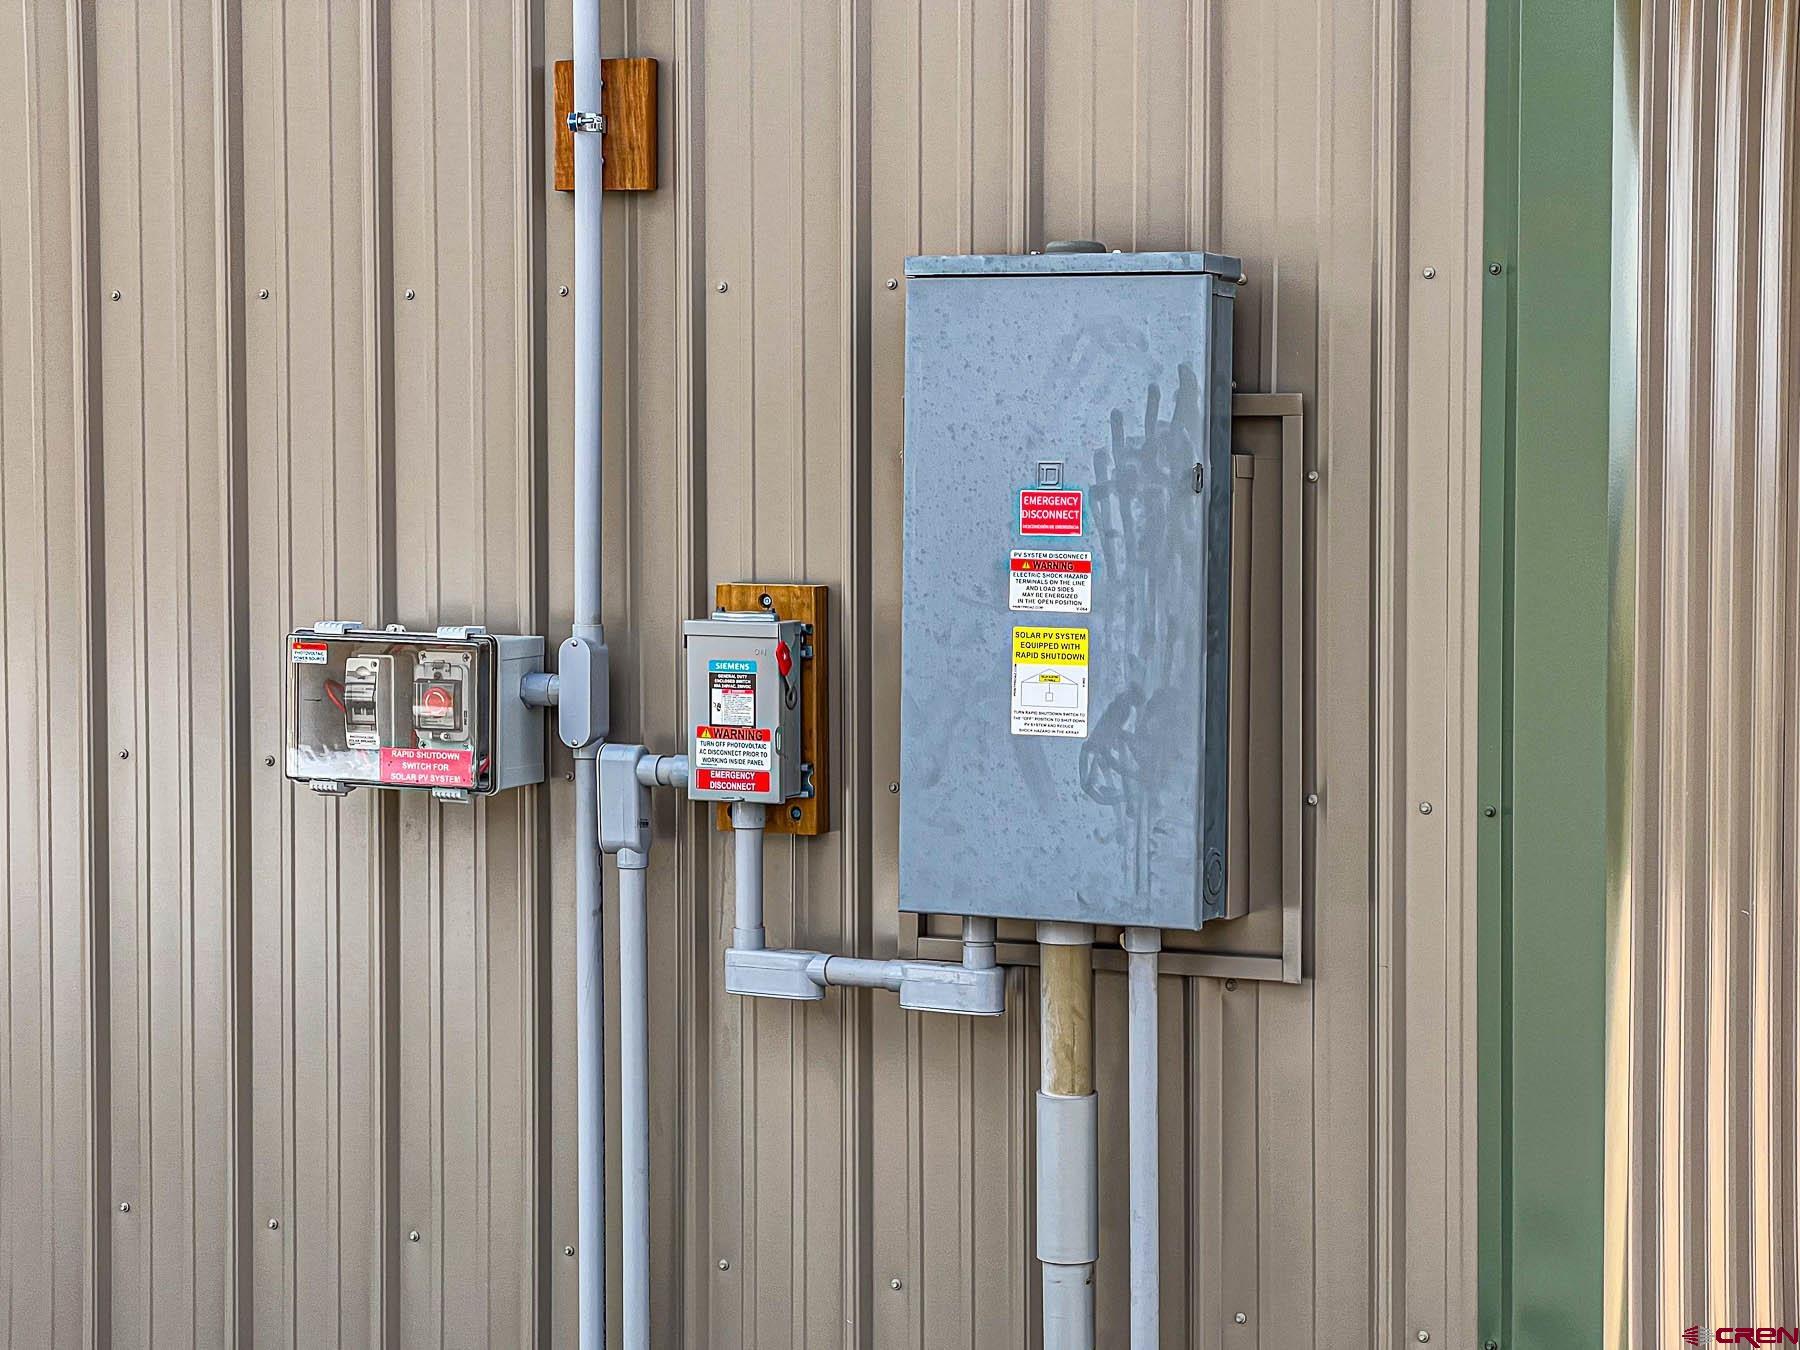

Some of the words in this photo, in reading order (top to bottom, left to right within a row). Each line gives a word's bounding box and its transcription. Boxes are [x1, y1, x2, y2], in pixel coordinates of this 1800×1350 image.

[1023, 495, 1079, 506] EMERGENCY
[1022, 509, 1080, 520] DISCONNECT
[1033, 561, 1074, 571] WARNING
[1015, 631, 1041, 639] SOLAR
[1055, 632, 1086, 640] SYSTEM
[1020, 641, 1059, 650] EQUIPPED
[1015, 651, 1039, 659] RAPID
[1040, 652, 1085, 661] SHUTDOWN
[715, 662, 750, 671] SIEMENS
[713, 727, 763, 741] WARNING
[726, 742, 767, 750] PHOTOVOLTAIC
[391, 750, 415, 759] RAPID
[416, 750, 460, 761] SHUTDOWN
[707, 749, 742, 757] DISCONNECT
[402, 761, 432, 771] SWITCH
[433, 763, 449, 772] FOR
[390, 772, 416, 781] SOLAR
[418, 773, 429, 782] PV
[430, 774, 461, 783] SYSTEM
[710, 770, 755, 780] EMERGENCY
[709, 781, 756, 791] DISCONNECT
